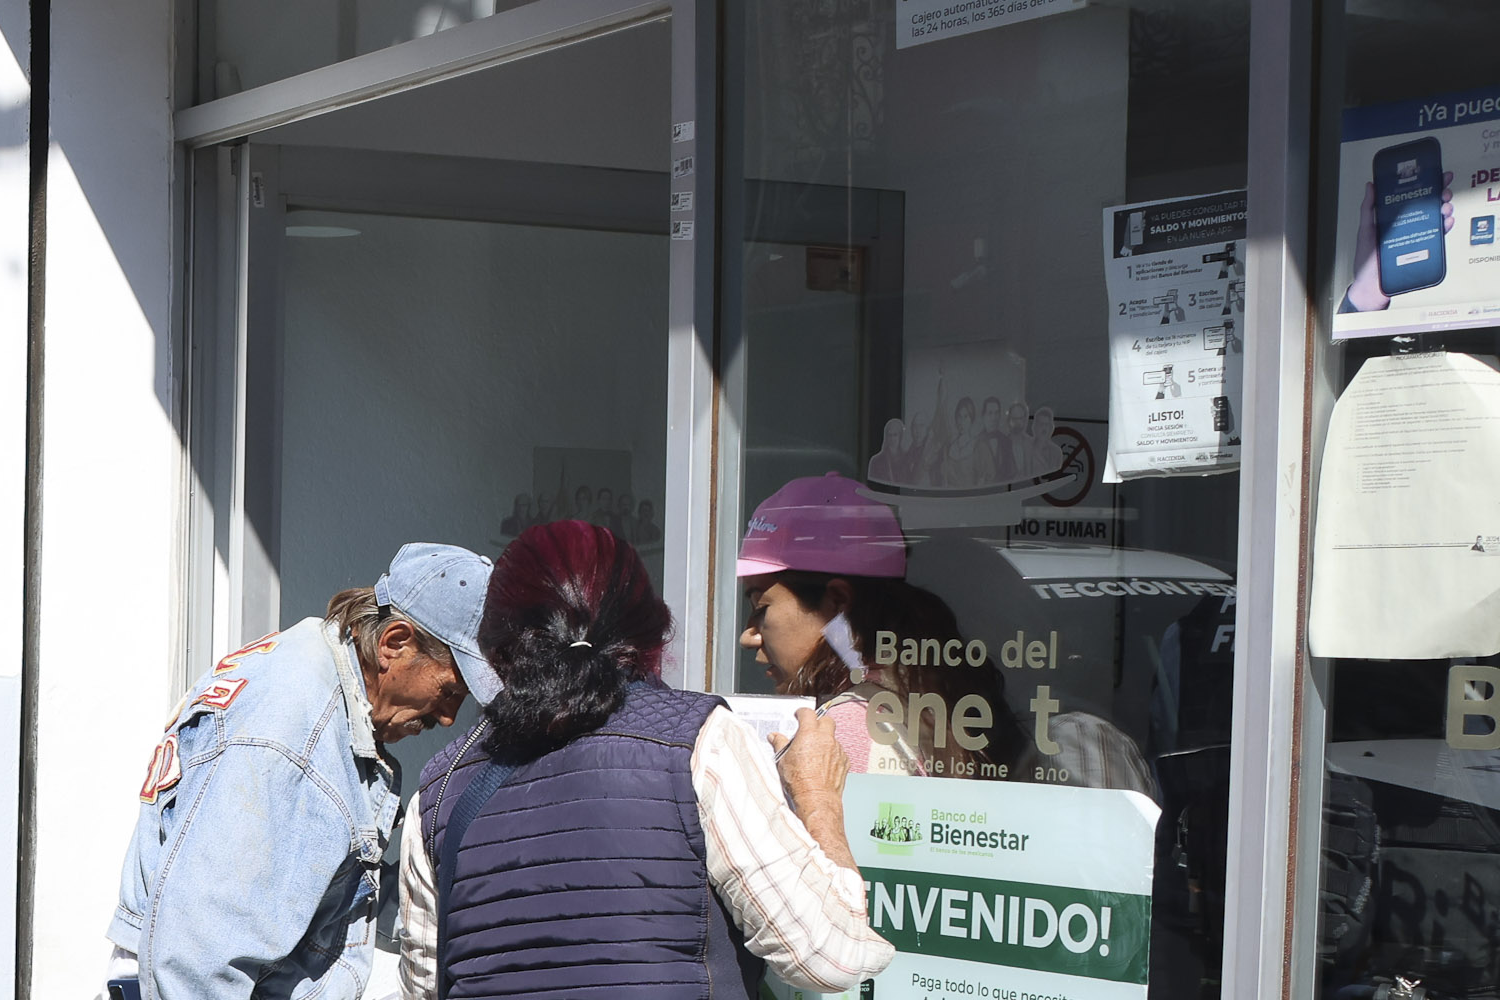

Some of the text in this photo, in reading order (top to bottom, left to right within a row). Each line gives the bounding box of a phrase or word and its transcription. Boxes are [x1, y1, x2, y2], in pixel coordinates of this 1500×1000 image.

[911, 9, 942, 25] Cajero
[911, 27, 925, 38] las
[926, 22, 938, 34] 24
[940, 16, 970, 31] horas,
[971, 12, 986, 23] los
[987, 6, 1005, 19] 365
[1007, 0, 1028, 14] días
[1418, 102, 1448, 127] ¡Ya
[1384, 185, 1433, 205] Bienestar
[1150, 223, 1180, 235] SALDO
[1180, 221, 1189, 230] Y
[1126, 266, 1132, 279] 1
[1188, 294, 1197, 306] 3
[1118, 302, 1127, 316] 2
[1132, 340, 1142, 352] 4
[1188, 370, 1196, 383] 5
[1148, 410, 1184, 424] ¡LISTO!
[1014, 519, 1107, 539] NO FUMAR
[875, 630, 1058, 670] Banco del
[923, 755, 944, 774] de
[950, 757, 974, 776] los
[931, 808, 987, 825] Banco del
[930, 822, 1030, 852] Bienestar
[912, 973, 942, 992] Paga
[945, 978, 974, 996] todo
[978, 982, 989, 997] lo
